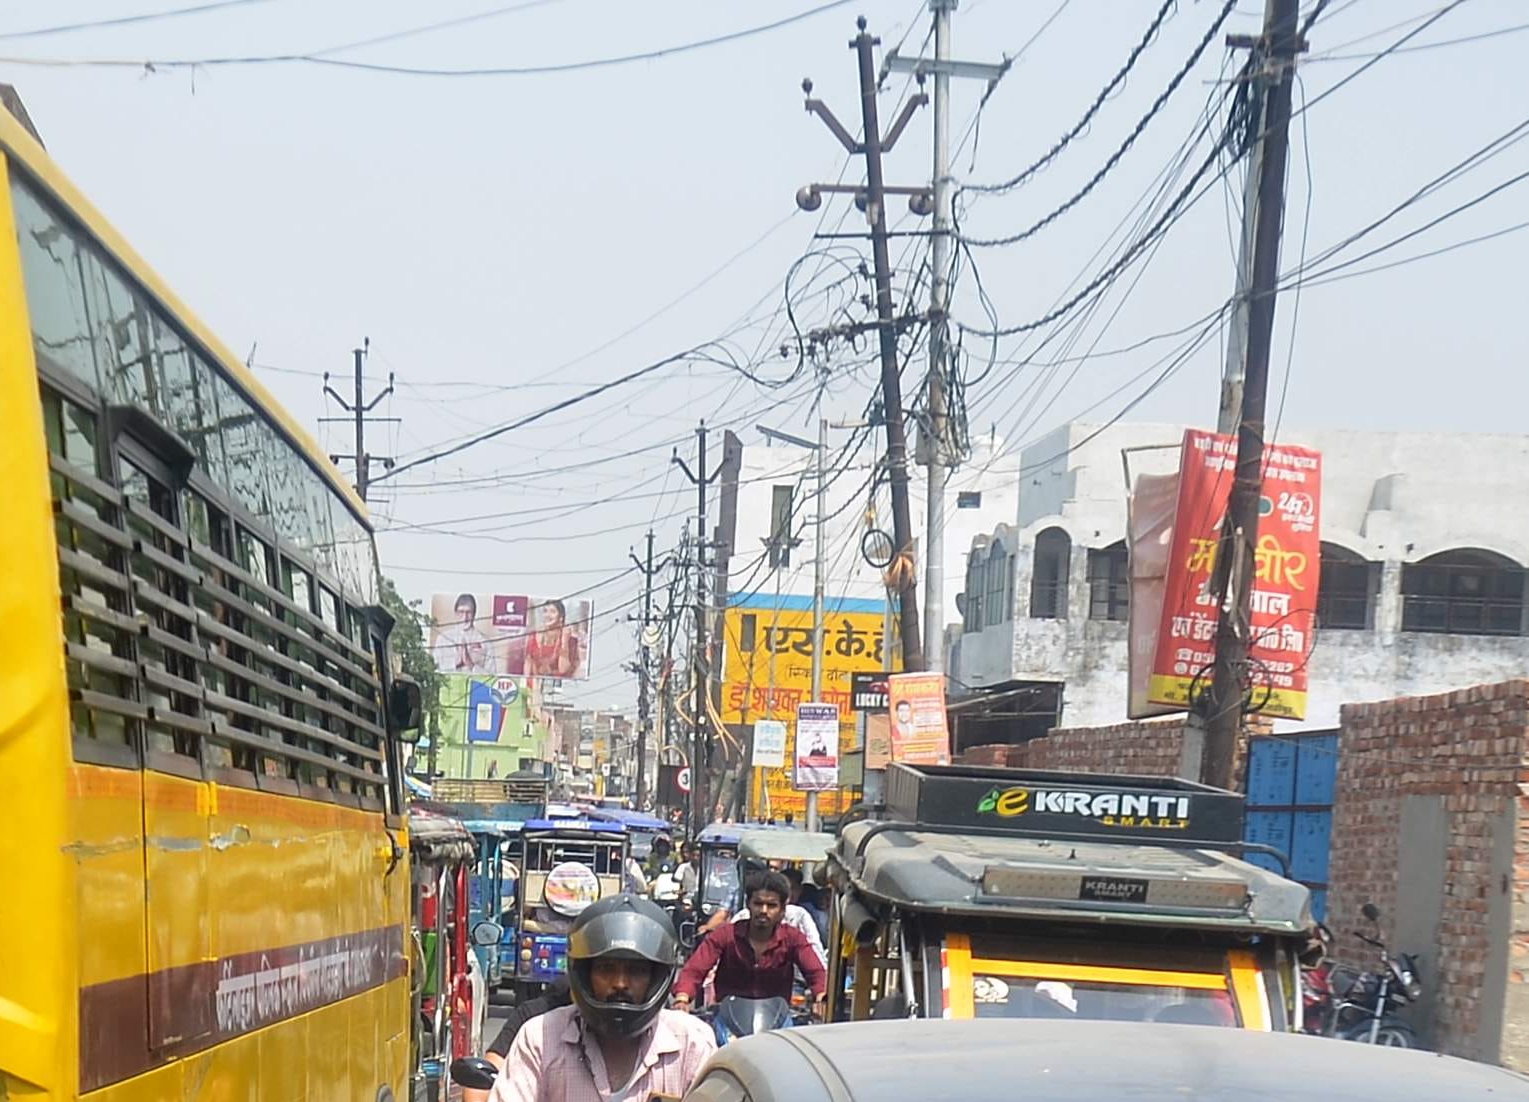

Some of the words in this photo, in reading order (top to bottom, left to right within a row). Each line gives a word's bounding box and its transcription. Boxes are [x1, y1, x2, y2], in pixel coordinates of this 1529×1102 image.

[1186, 534, 1306, 591] मवीर
[855, 693, 881, 707] LUCKY
[1034, 791, 1189, 818] KRANTI
[1101, 815, 1190, 829] SMART
[1084, 880, 1144, 894] KRANTI
